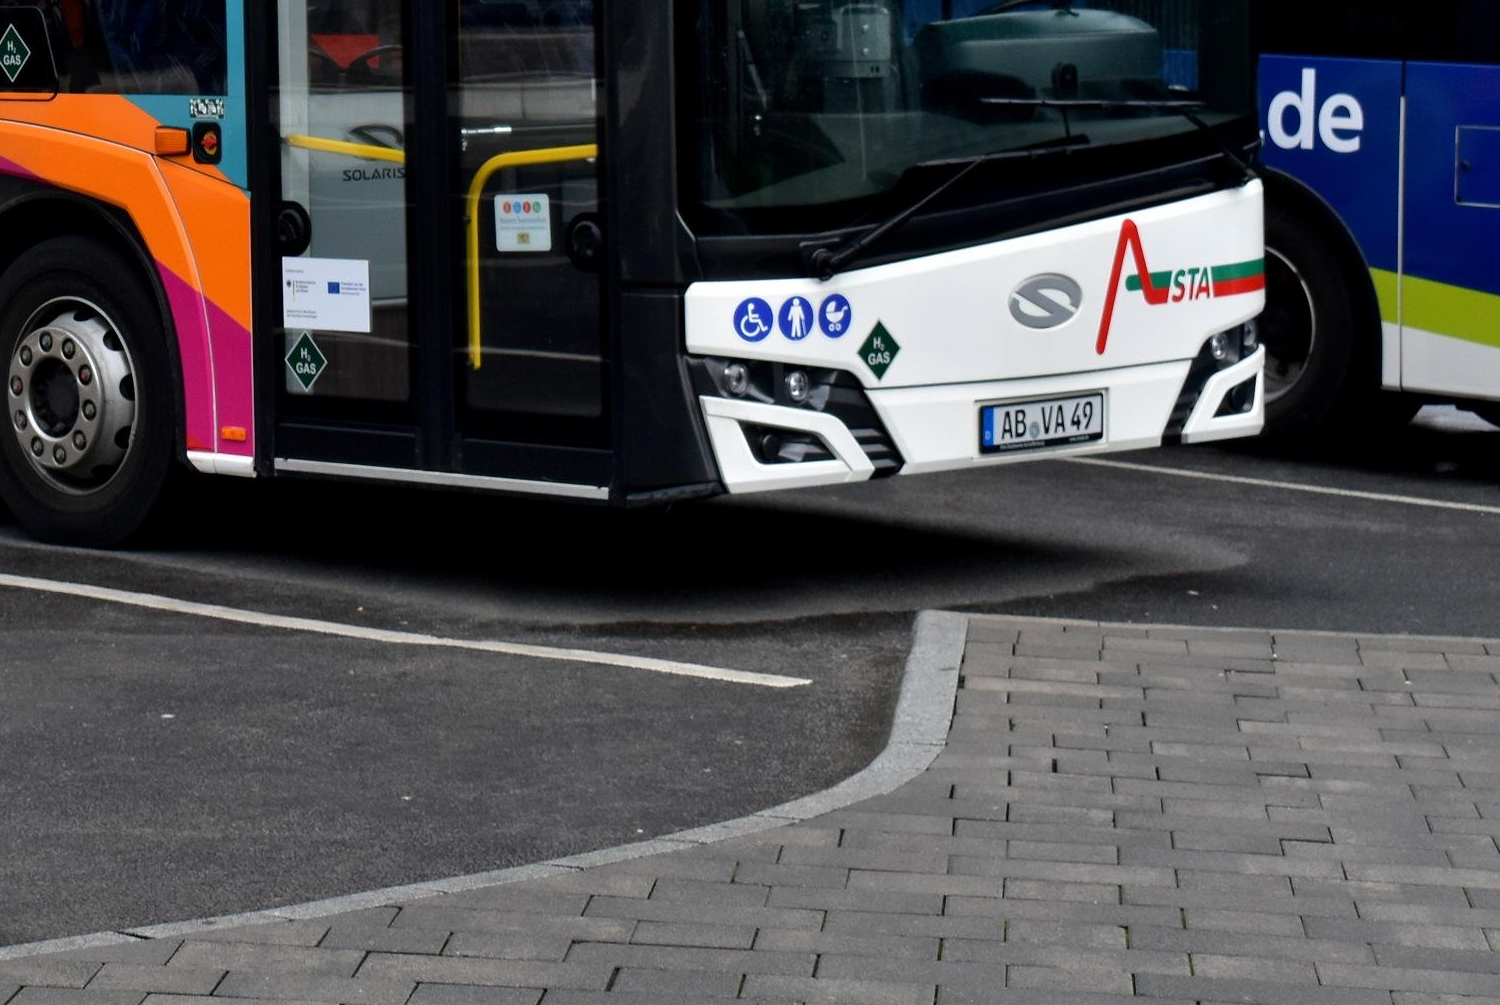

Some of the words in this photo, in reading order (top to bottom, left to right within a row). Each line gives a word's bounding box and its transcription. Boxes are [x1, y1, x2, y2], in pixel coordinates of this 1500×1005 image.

[3, 54, 21, 66] GAS
[343, 168, 406, 182] SOLARIS
[867, 351, 891, 366] GAS
[296, 362, 317, 375] GAS
[1001, 409, 1028, 441] AB
[1041, 404, 1066, 435] VA
[1070, 401, 1094, 431] 49
